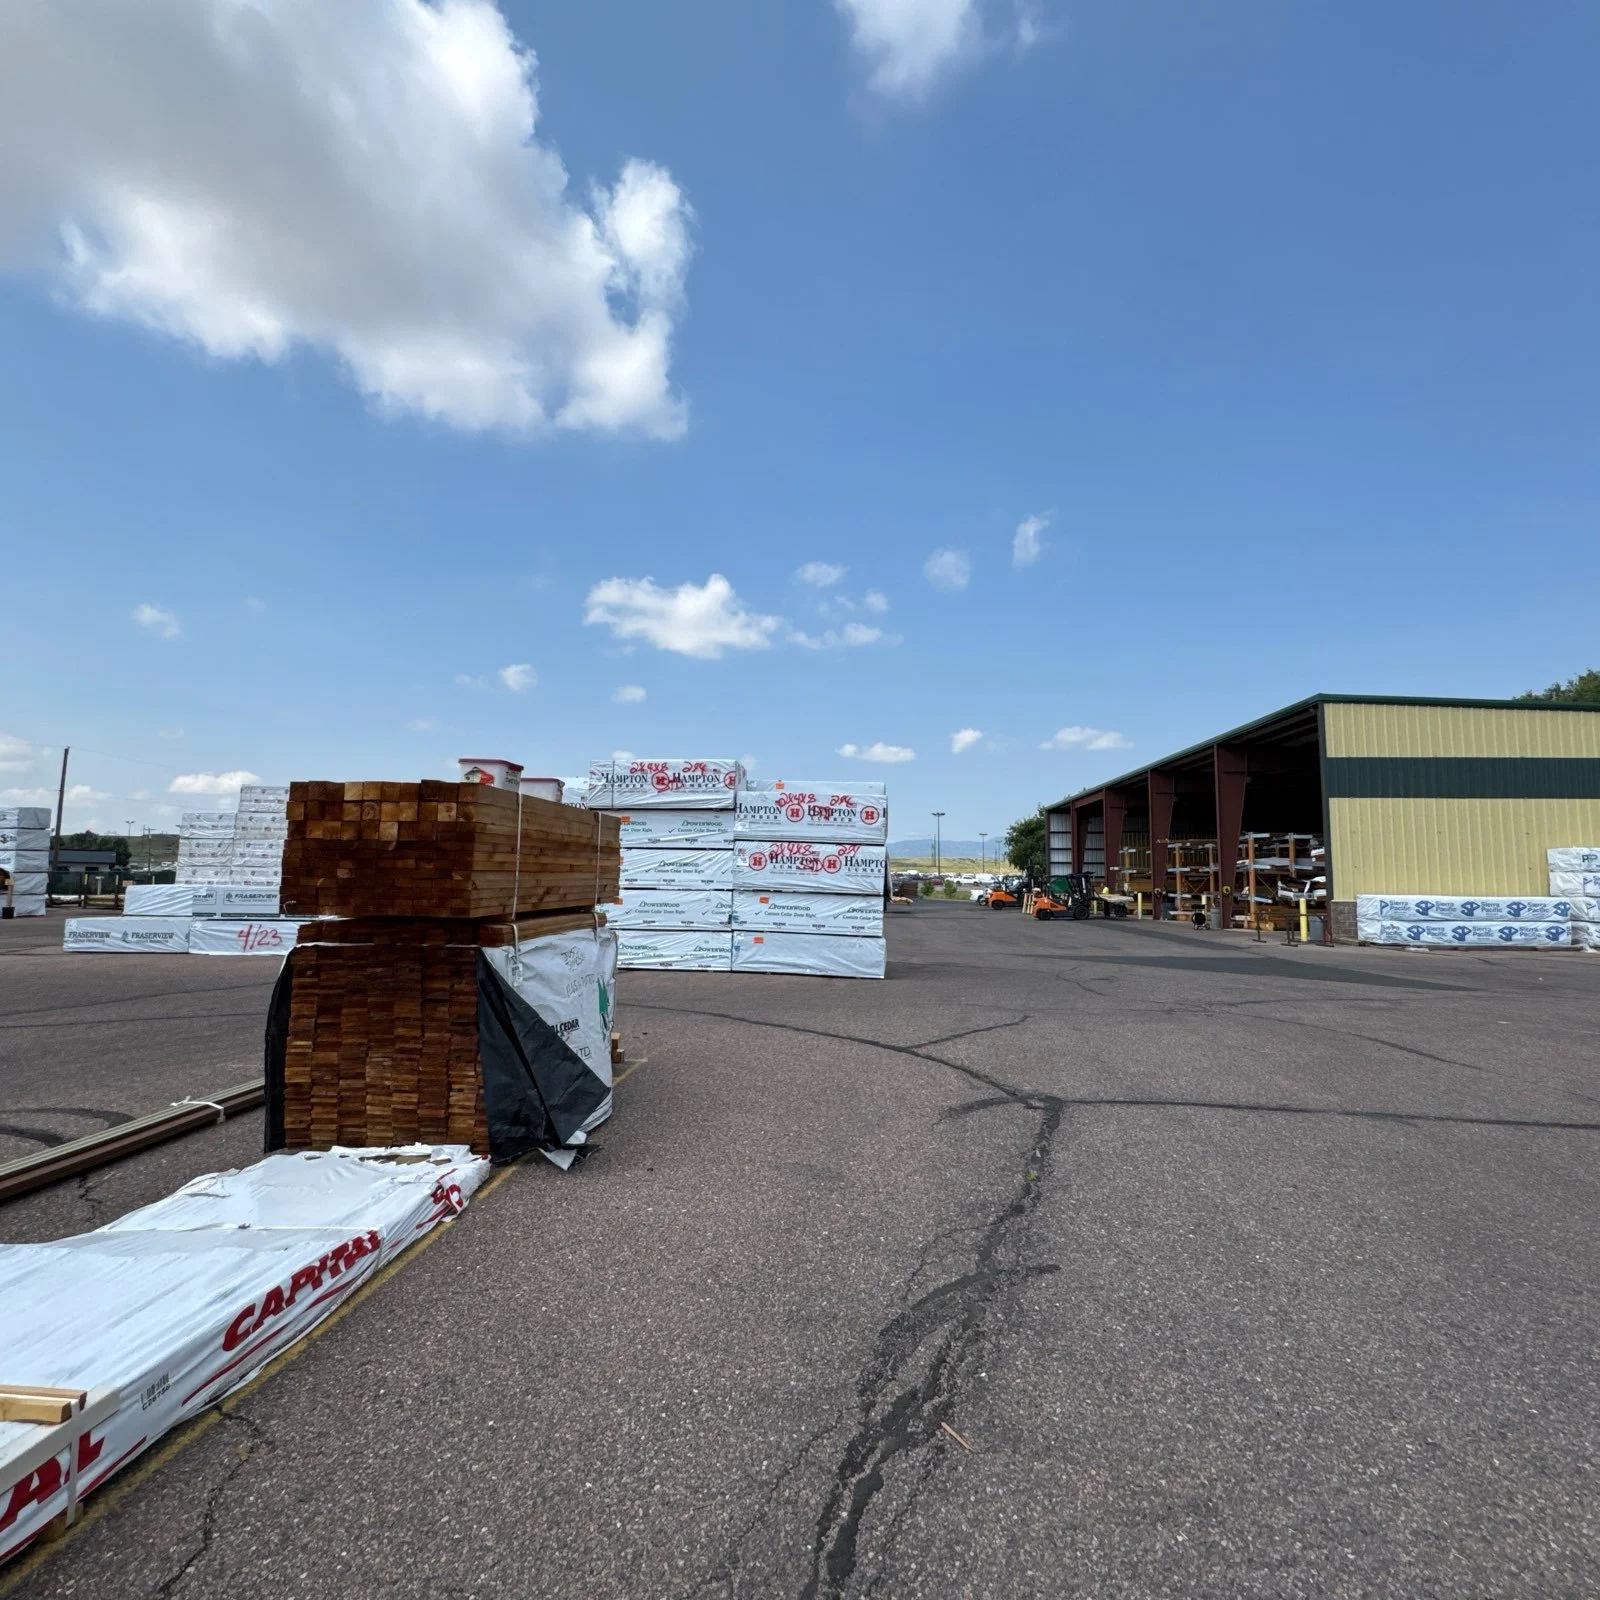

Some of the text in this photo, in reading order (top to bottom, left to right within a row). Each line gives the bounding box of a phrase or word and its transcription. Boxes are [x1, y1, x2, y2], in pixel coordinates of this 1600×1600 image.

[602, 773, 648, 783] HAMPTON
[673, 772, 720, 784] HAMPTON
[735, 803, 782, 815] HAMPTON
[131, 932, 175, 940] FRASERVIEW
[237, 924, 283, 952] 4/23
